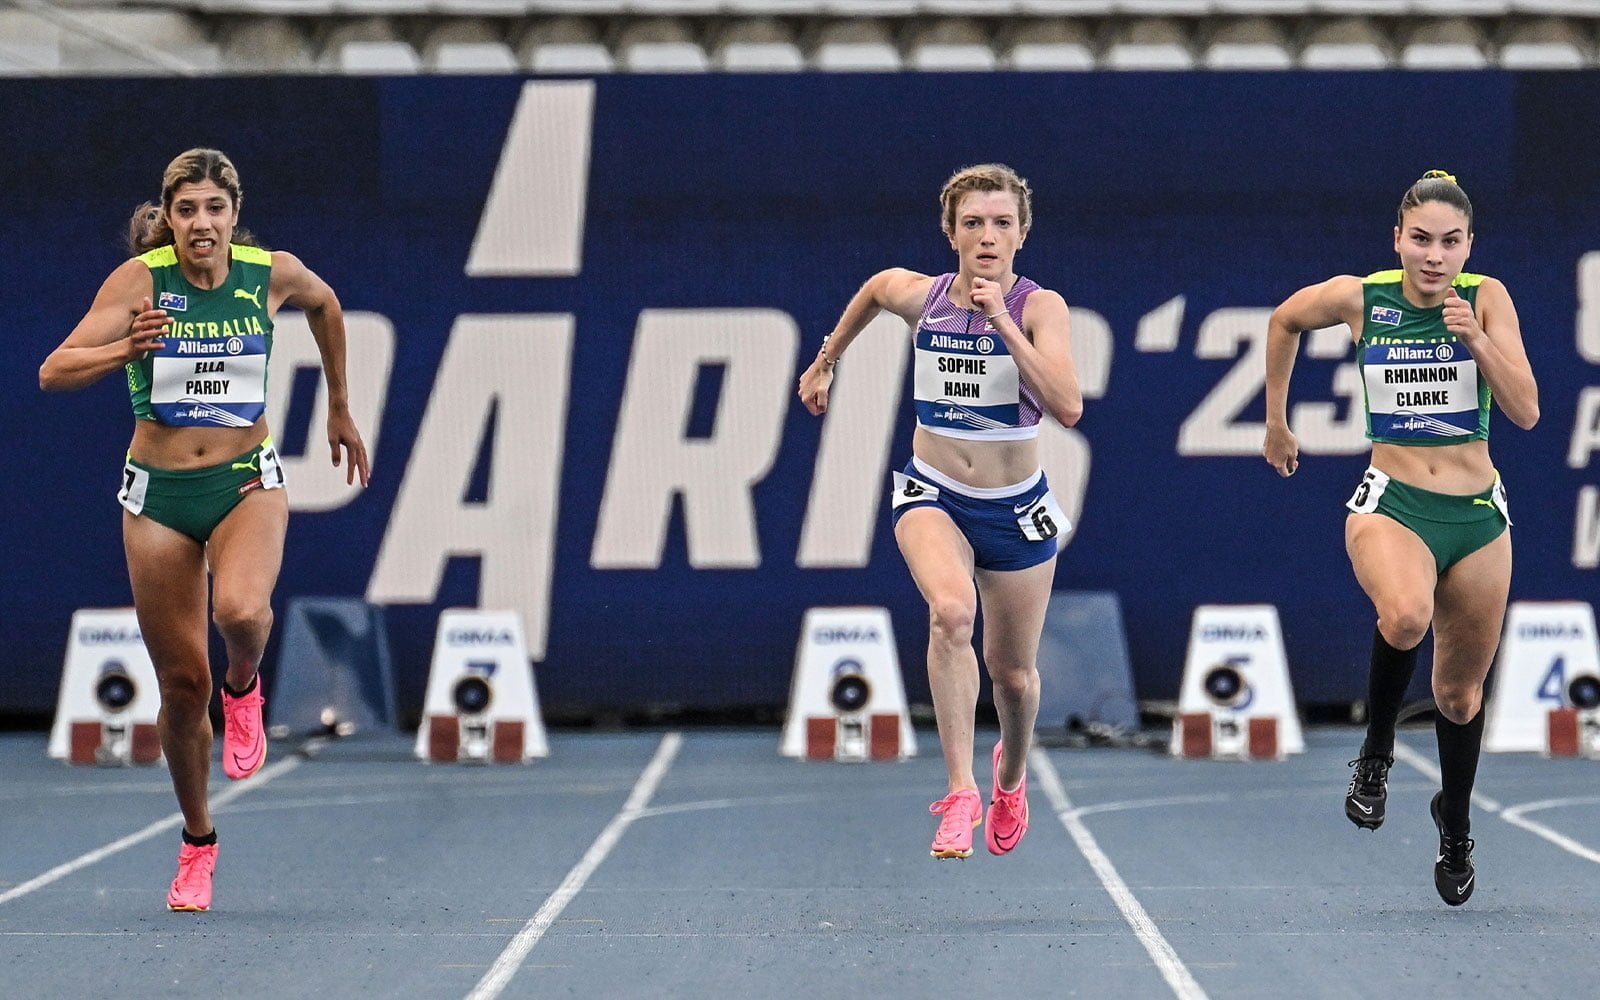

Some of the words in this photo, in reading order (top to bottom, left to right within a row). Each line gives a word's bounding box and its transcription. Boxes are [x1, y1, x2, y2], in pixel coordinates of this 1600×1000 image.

[177, 341, 224, 354] Allianz
[930, 334, 974, 350] Allianz
[1386, 347, 1434, 360] Allianz
[195, 361, 225, 374] ELLA
[938, 356, 986, 374] SOPHIE
[1384, 366, 1458, 384] RHIANNON
[186, 380, 230, 394] PARDY
[944, 382, 980, 398] HAHN
[1396, 391, 1448, 407] CLARKE
[1031, 506, 1058, 540] 6
[1535, 656, 1565, 709] 4
